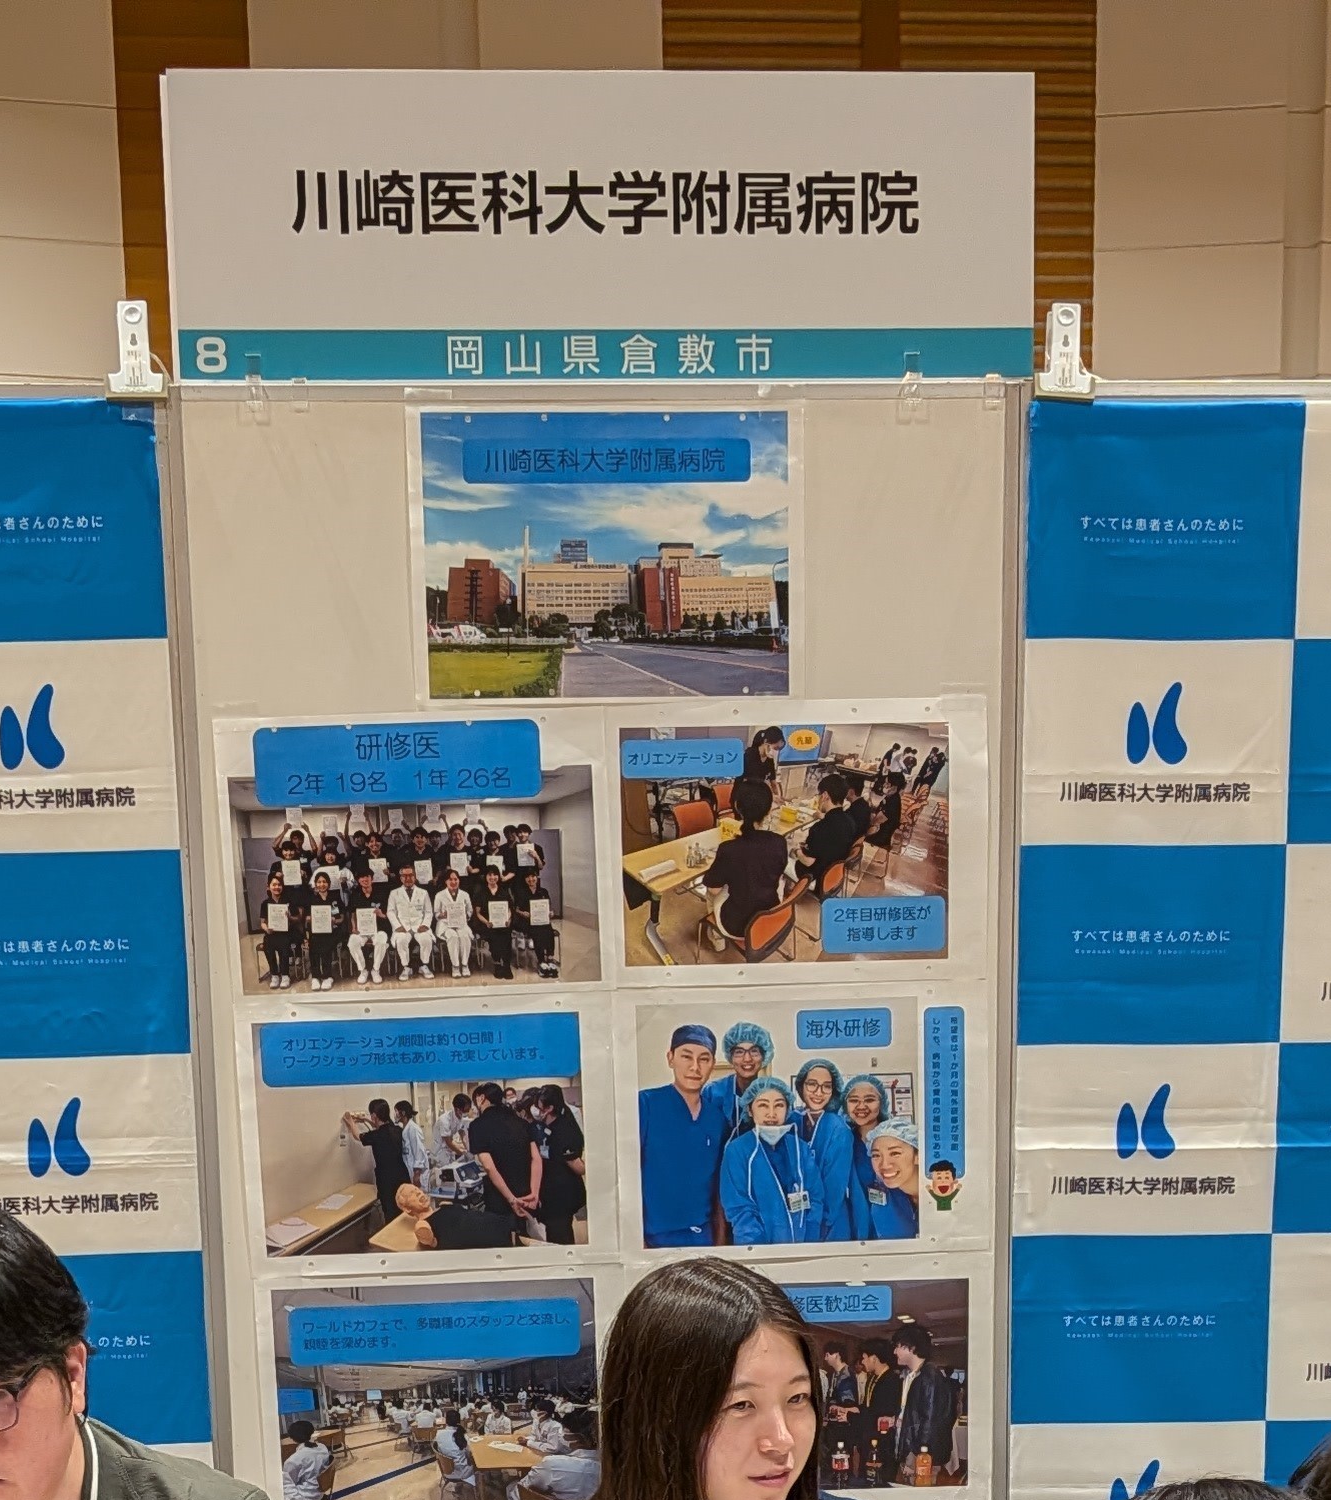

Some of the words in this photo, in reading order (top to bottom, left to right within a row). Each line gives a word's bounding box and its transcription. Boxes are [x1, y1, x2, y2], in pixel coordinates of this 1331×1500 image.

[291, 166, 920, 237] 川崎医科大学附属病院
[195, 336, 228, 374] 8
[446, 335, 774, 377] 岡山県倉敷市
[484, 446, 726, 475] 川崎医科大学附属病院
[1080, 515, 1244, 532] すべては患者さんのために
[355, 730, 441, 761] 研修医
[627, 751, 739, 767] オリエンテーション
[287, 772, 325, 795] 2年
[335, 771, 388, 794] 19名
[413, 769, 448, 790] 1年
[457, 766, 512, 790] 26名
[1059, 782, 1251, 804] 川崎医科大学附属病院
[834, 904, 932, 924] 2年目研修医が
[846, 925, 918, 943] 指導します
[1071, 929, 1231, 943] すべては患者さんのために
[805, 1017, 881, 1040] 海外研修
[1050, 1176, 1236, 1196] 川崎医科大学附属病院
[1062, 1314, 1216, 1327] すべては患者さんのために
